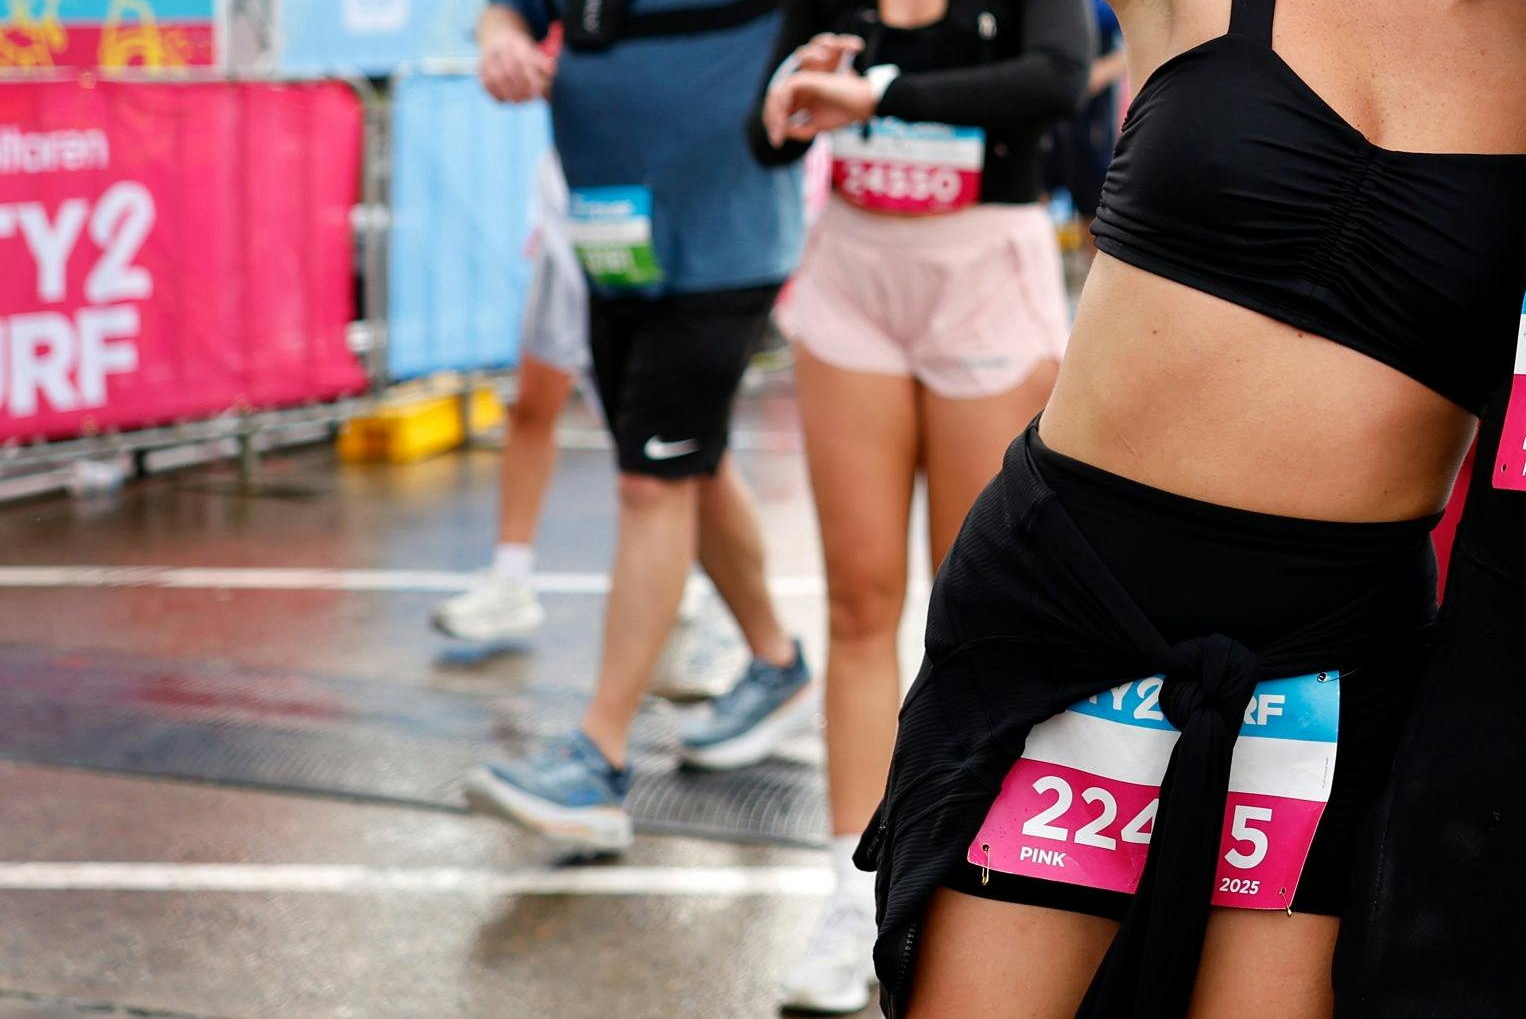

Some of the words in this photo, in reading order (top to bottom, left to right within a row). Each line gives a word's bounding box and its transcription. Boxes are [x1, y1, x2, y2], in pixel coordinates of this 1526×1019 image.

[0, 303, 140, 419] RF
[1019, 846, 1066, 869] PINK
[1219, 877, 1261, 896] 2025
